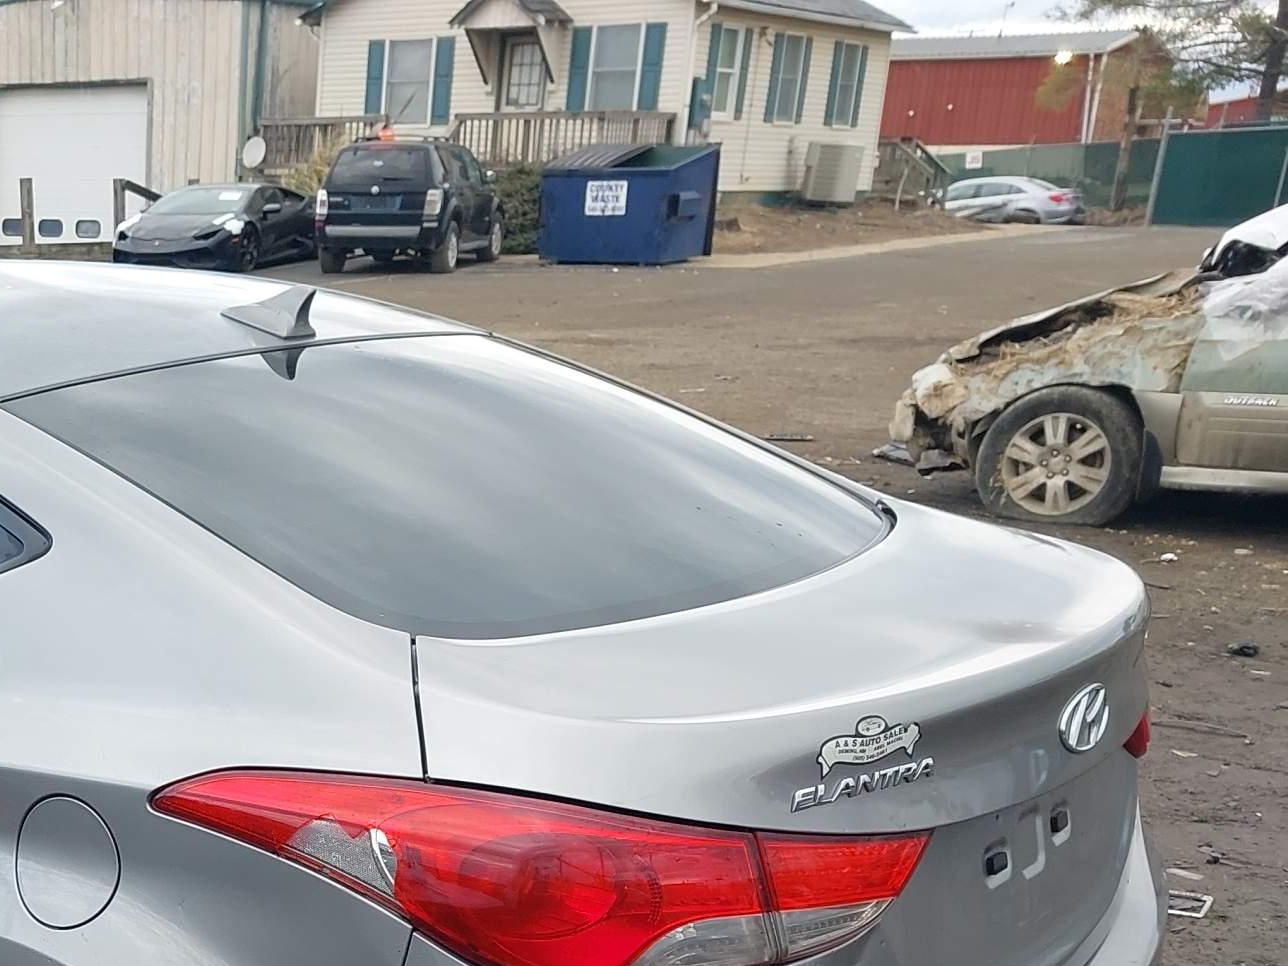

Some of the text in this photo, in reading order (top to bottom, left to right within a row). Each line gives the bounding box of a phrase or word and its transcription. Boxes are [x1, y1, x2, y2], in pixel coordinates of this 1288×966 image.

[591, 195, 620, 203] WASTE
[1223, 395, 1280, 407] OUTBACK
[834, 740, 841, 749] A
[843, 739, 849, 747] &
[851, 739, 858, 747] S
[859, 736, 881, 747] AUTO
[791, 757, 934, 813] ELANTRA
